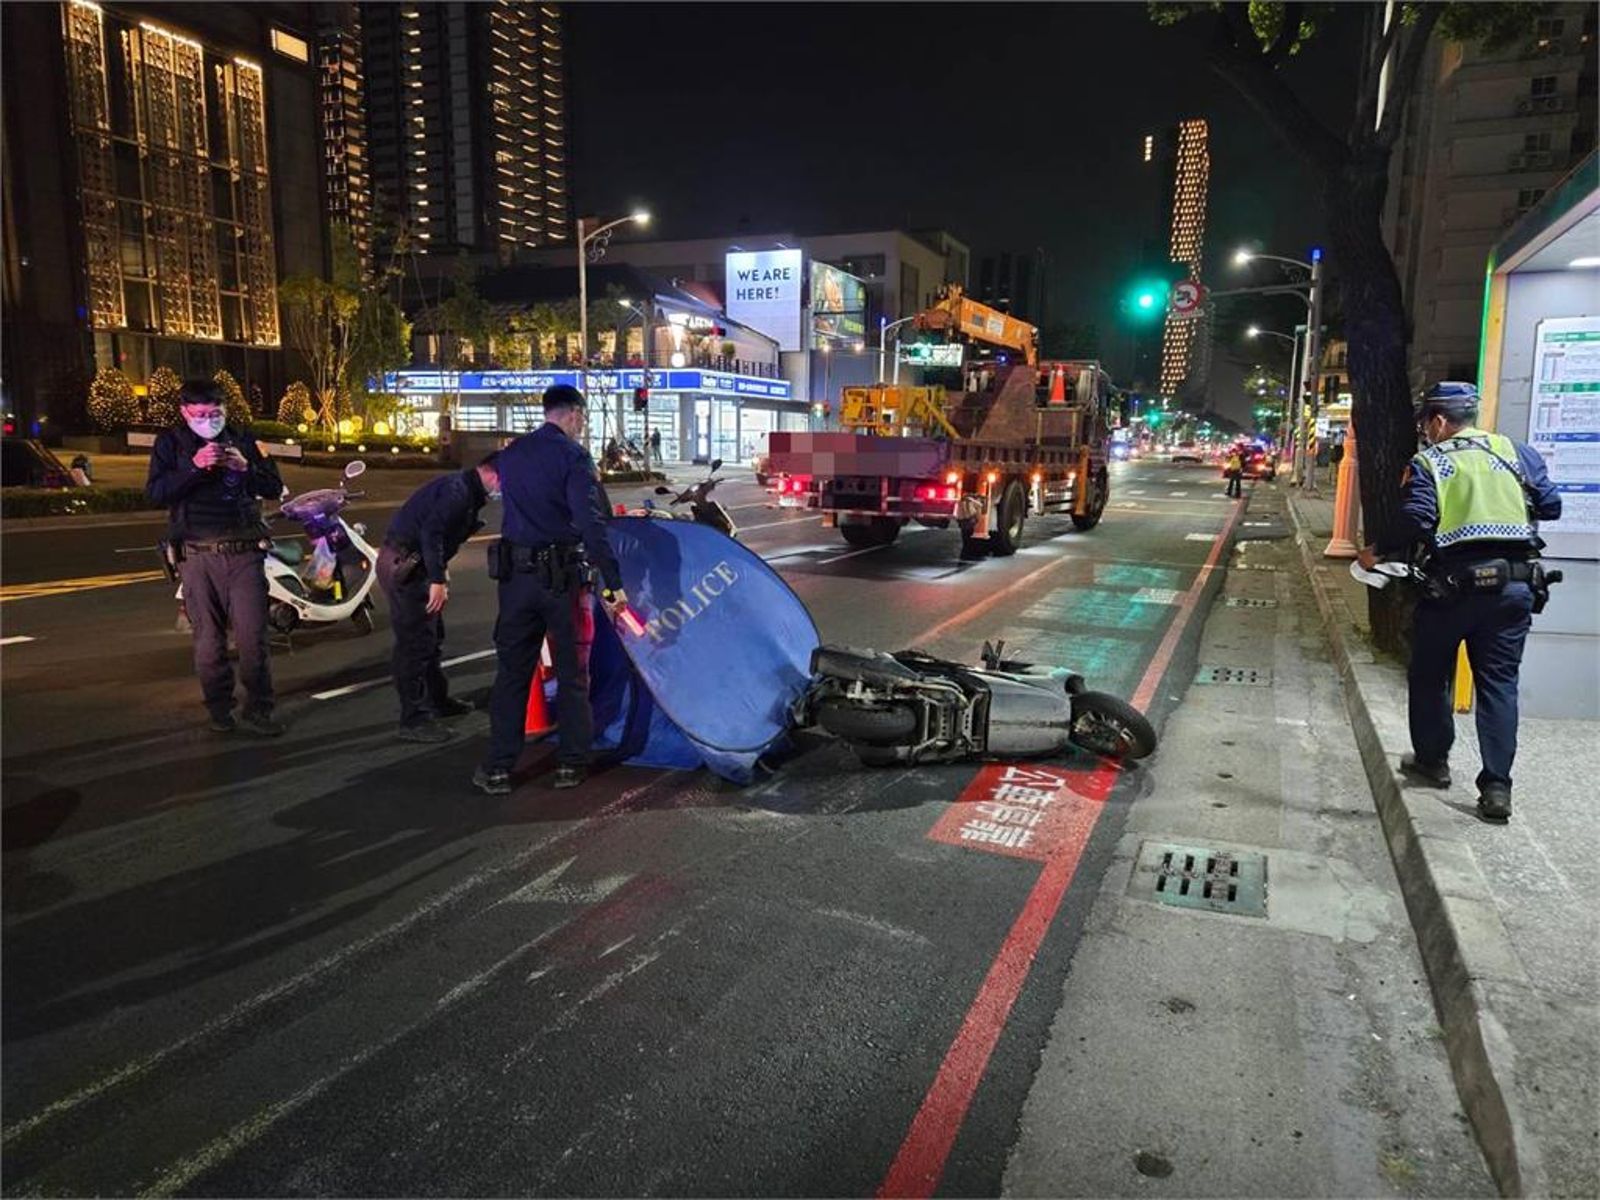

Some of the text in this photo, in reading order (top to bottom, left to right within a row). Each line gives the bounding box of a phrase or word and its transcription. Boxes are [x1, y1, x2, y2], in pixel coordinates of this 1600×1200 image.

[737, 268, 790, 281] WE ARE
[736, 287, 778, 300] HERE!
[646, 560, 738, 643] POLICE
